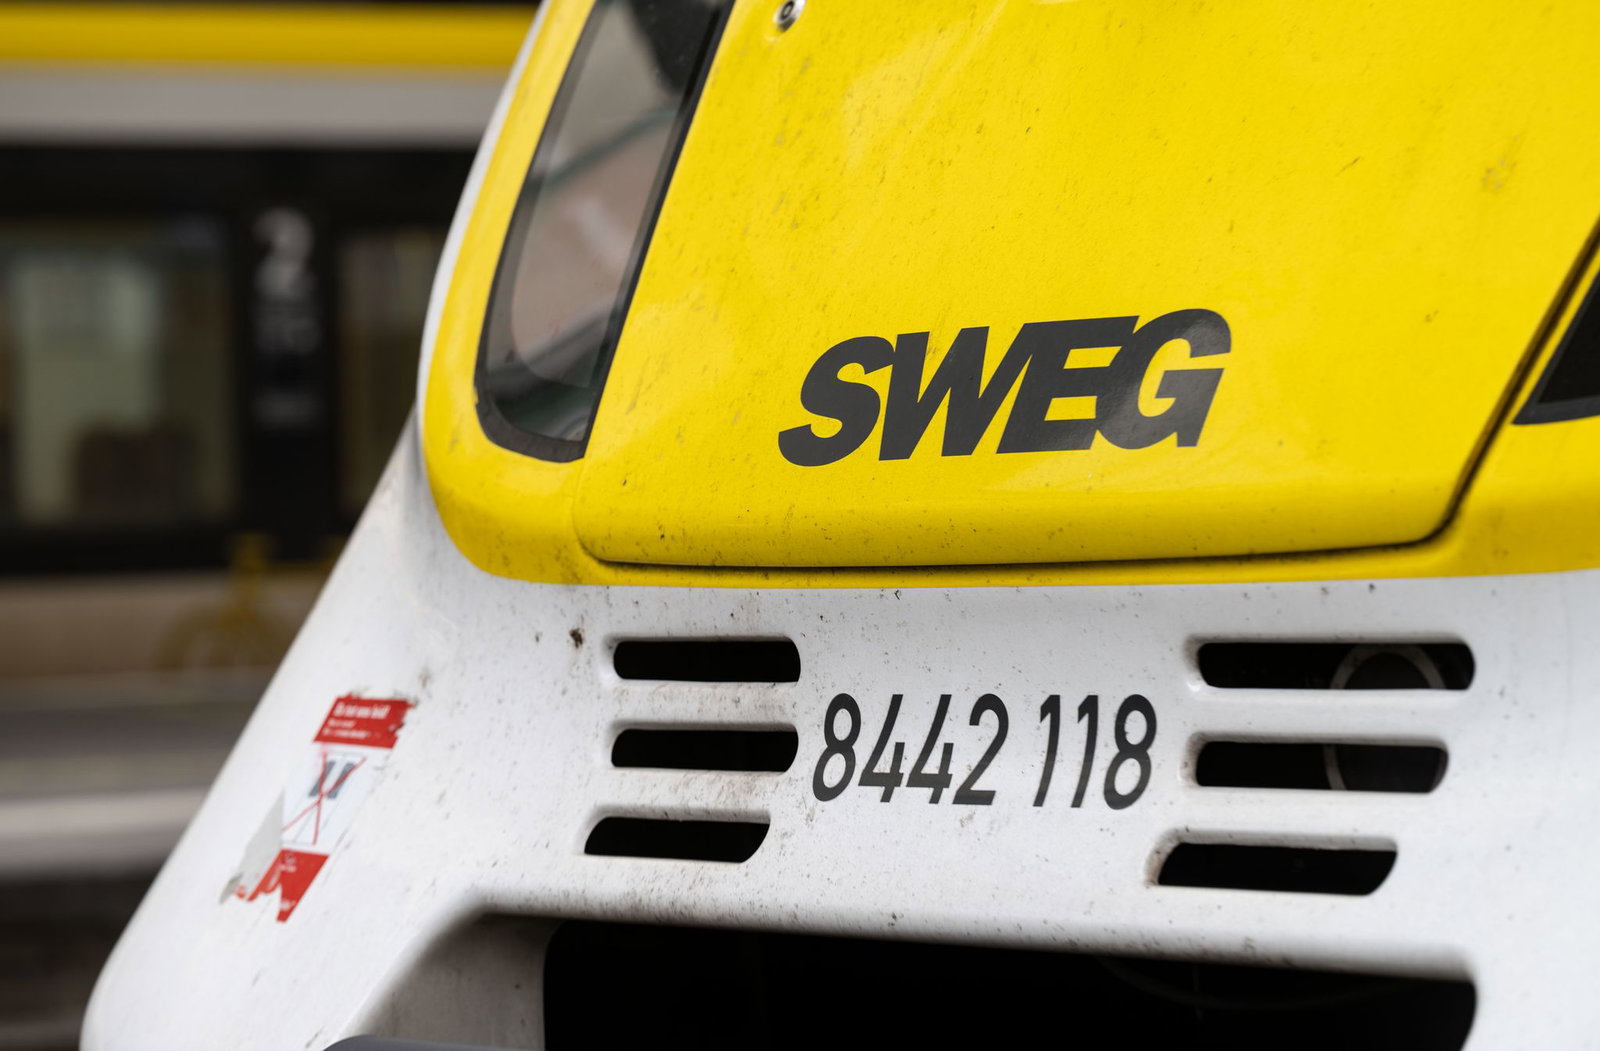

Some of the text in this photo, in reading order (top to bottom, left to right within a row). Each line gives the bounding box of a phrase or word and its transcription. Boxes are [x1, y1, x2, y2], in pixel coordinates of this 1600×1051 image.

[778, 308, 1232, 467] SWEG
[813, 693, 1158, 809] 8442 118
